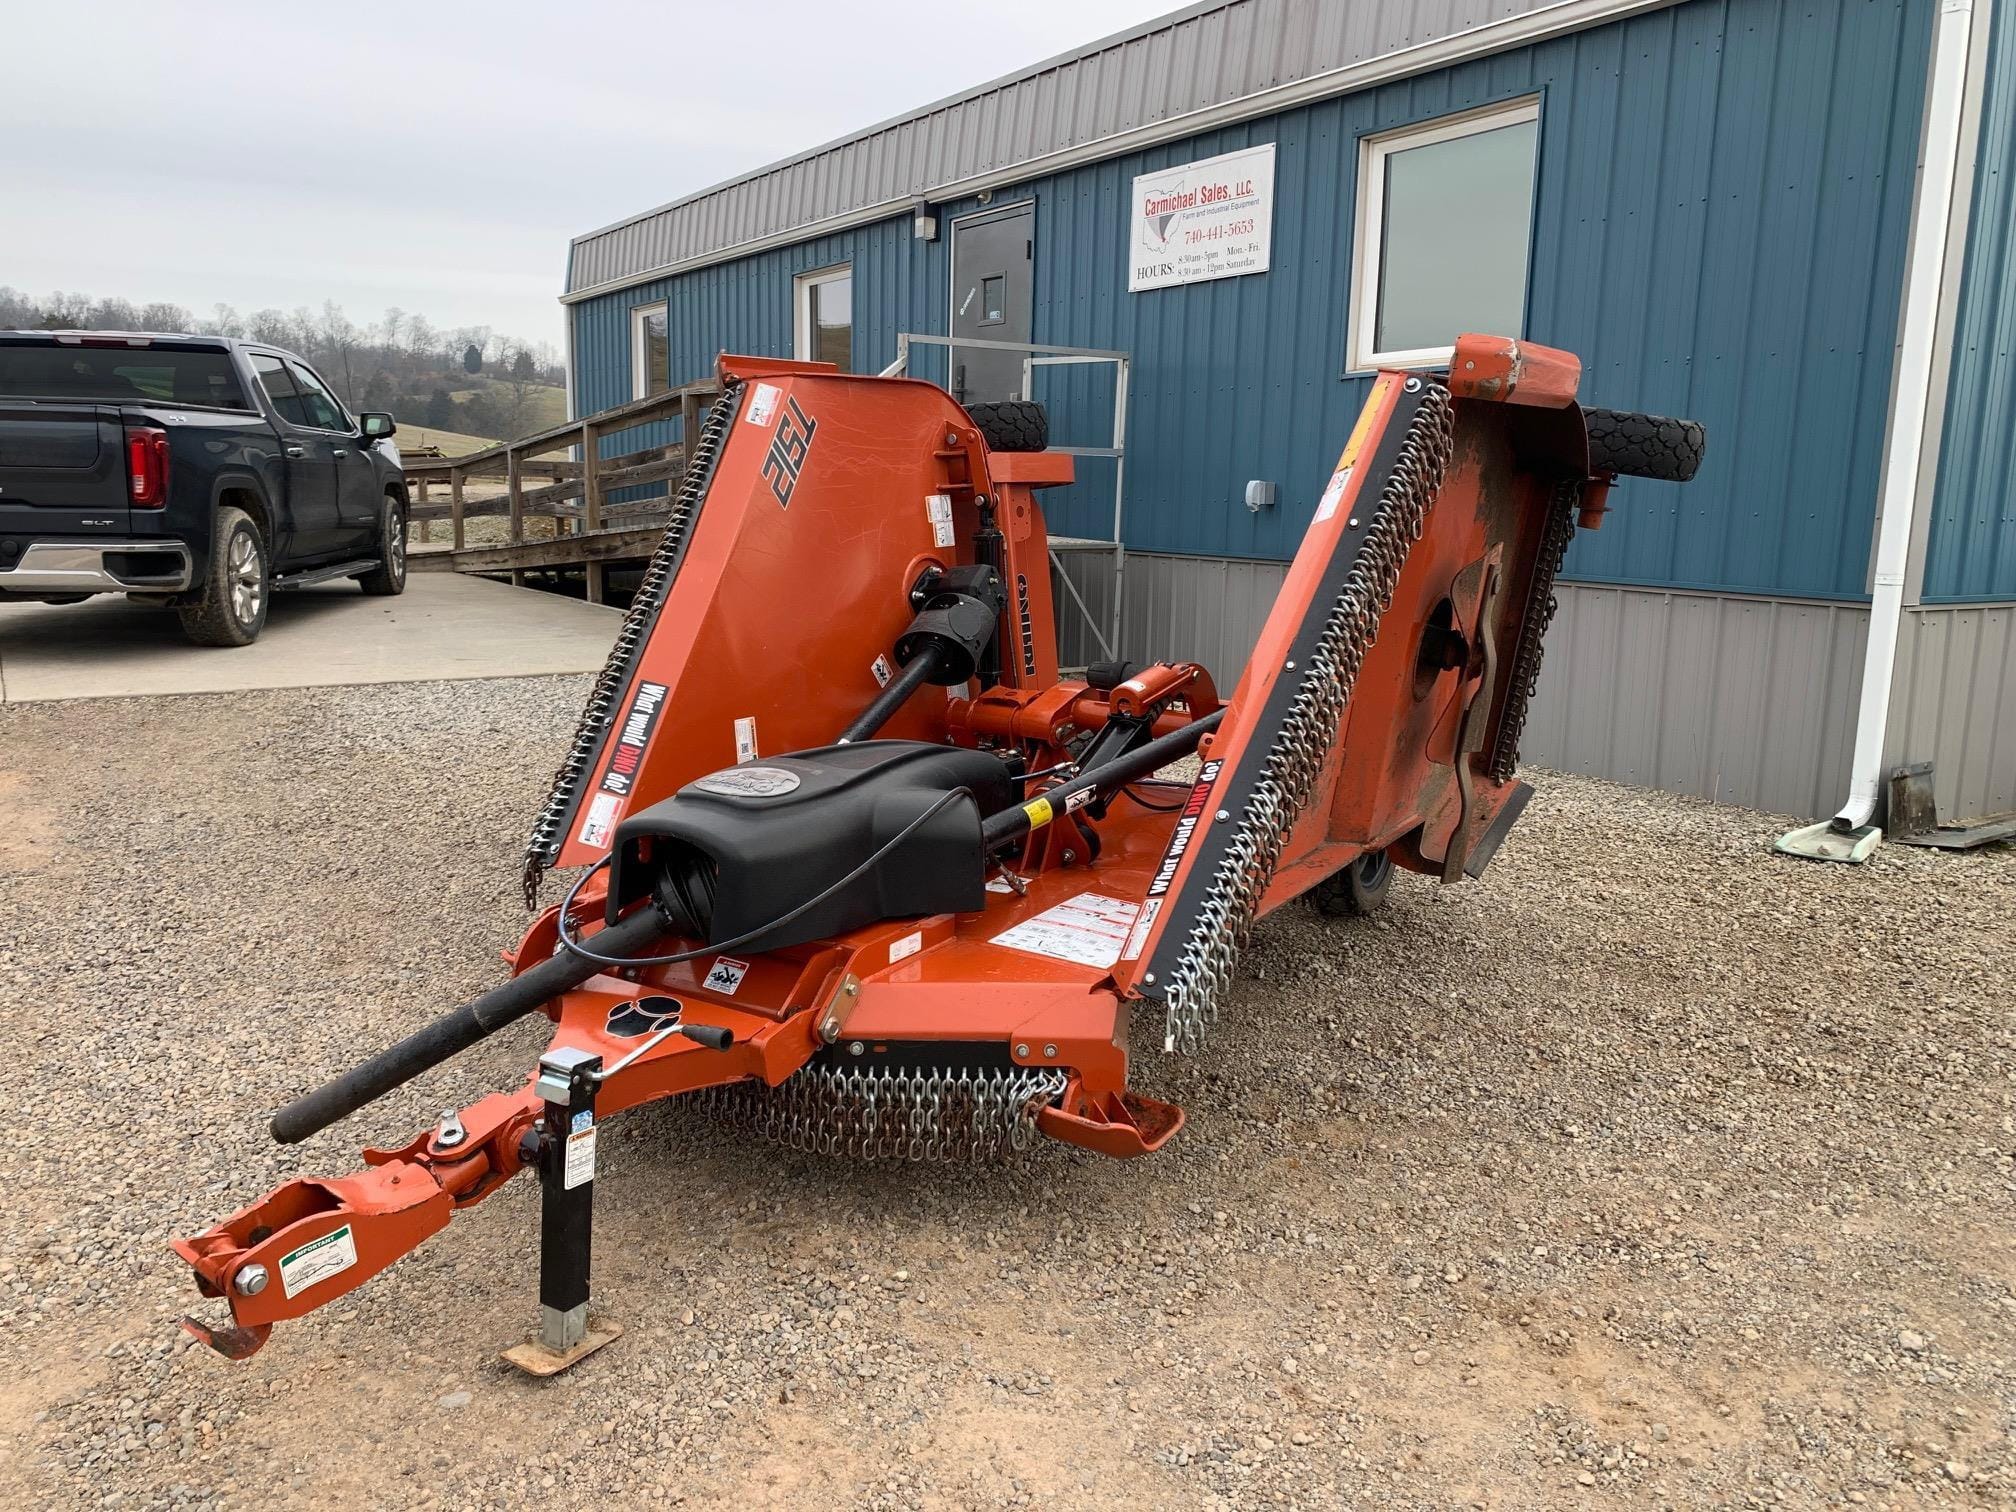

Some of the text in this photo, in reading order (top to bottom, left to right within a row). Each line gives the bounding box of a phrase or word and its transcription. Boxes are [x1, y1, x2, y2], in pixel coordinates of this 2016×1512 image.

[1145, 187, 1197, 216] Carmichael
[1236, 180, 1254, 196] LLC.
[1182, 198, 1260, 220] Farm and Industrial Equipment
[1185, 218, 1254, 245] 740-441-5653
[1137, 262, 1175, 280] HOURS:
[1226, 257, 1256, 270] Saturday
[603, 683, 667, 796] What would DINO do?
[1149, 760, 1224, 895] What would DINO do?
[295, 1236, 335, 1258] IMPORTANT
